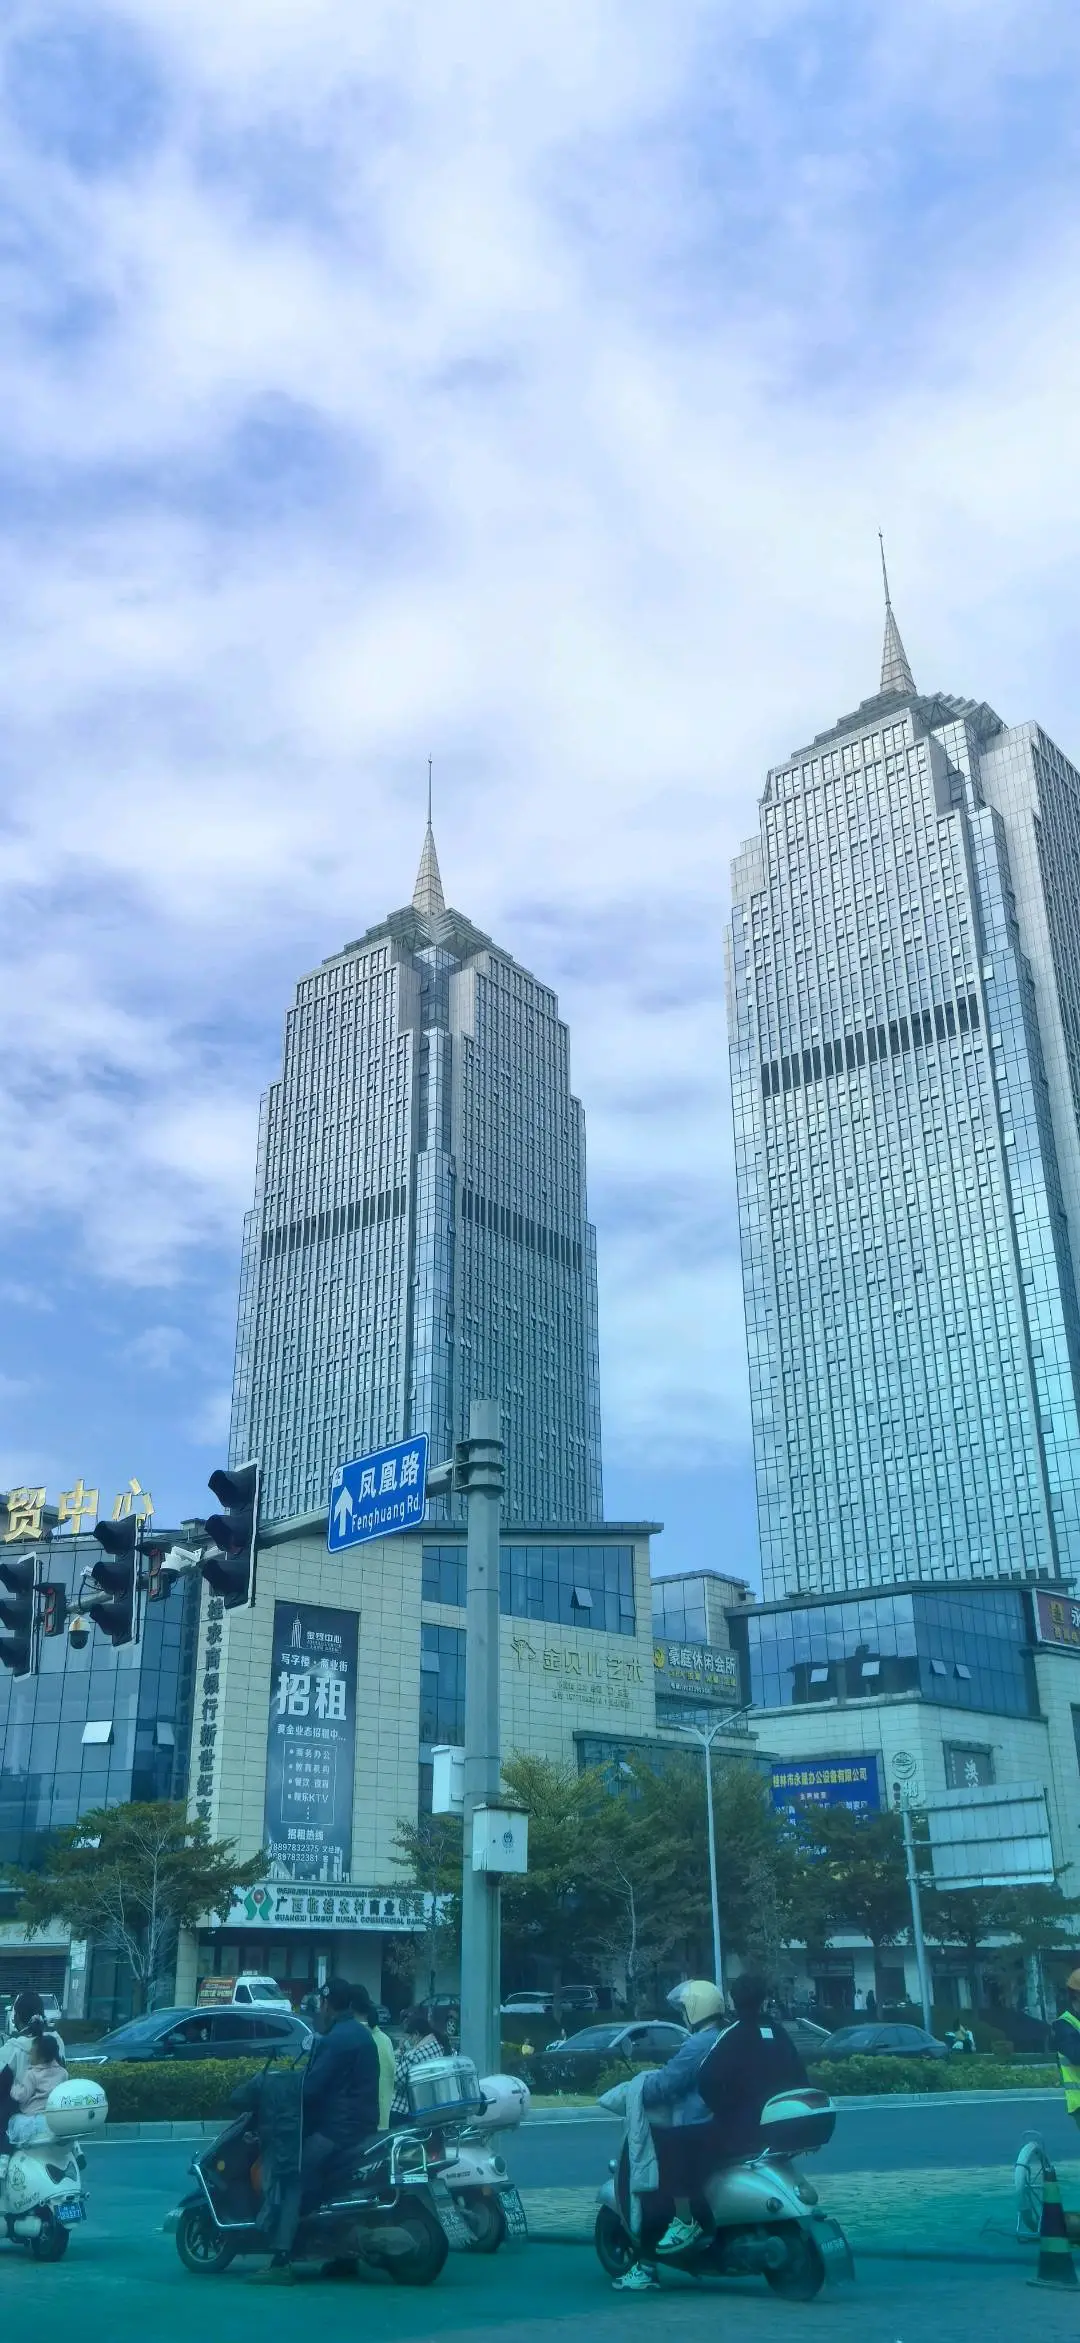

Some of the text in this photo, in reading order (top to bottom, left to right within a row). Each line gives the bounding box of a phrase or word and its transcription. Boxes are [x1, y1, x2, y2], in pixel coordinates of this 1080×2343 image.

[358, 1450, 419, 1503] 凤凰路
[4, 1477, 155, 1543] 贸中心
[351, 1501, 405, 1533] Fenghuang
[543, 1648, 644, 1683] 金贝儿艺术
[668, 1646, 736, 1675] 豪庭休闲会所
[277, 1671, 347, 1720] 招租
[287, 1828, 324, 1840] 招租热线
[275, 1914, 306, 1922] GUANGXI
